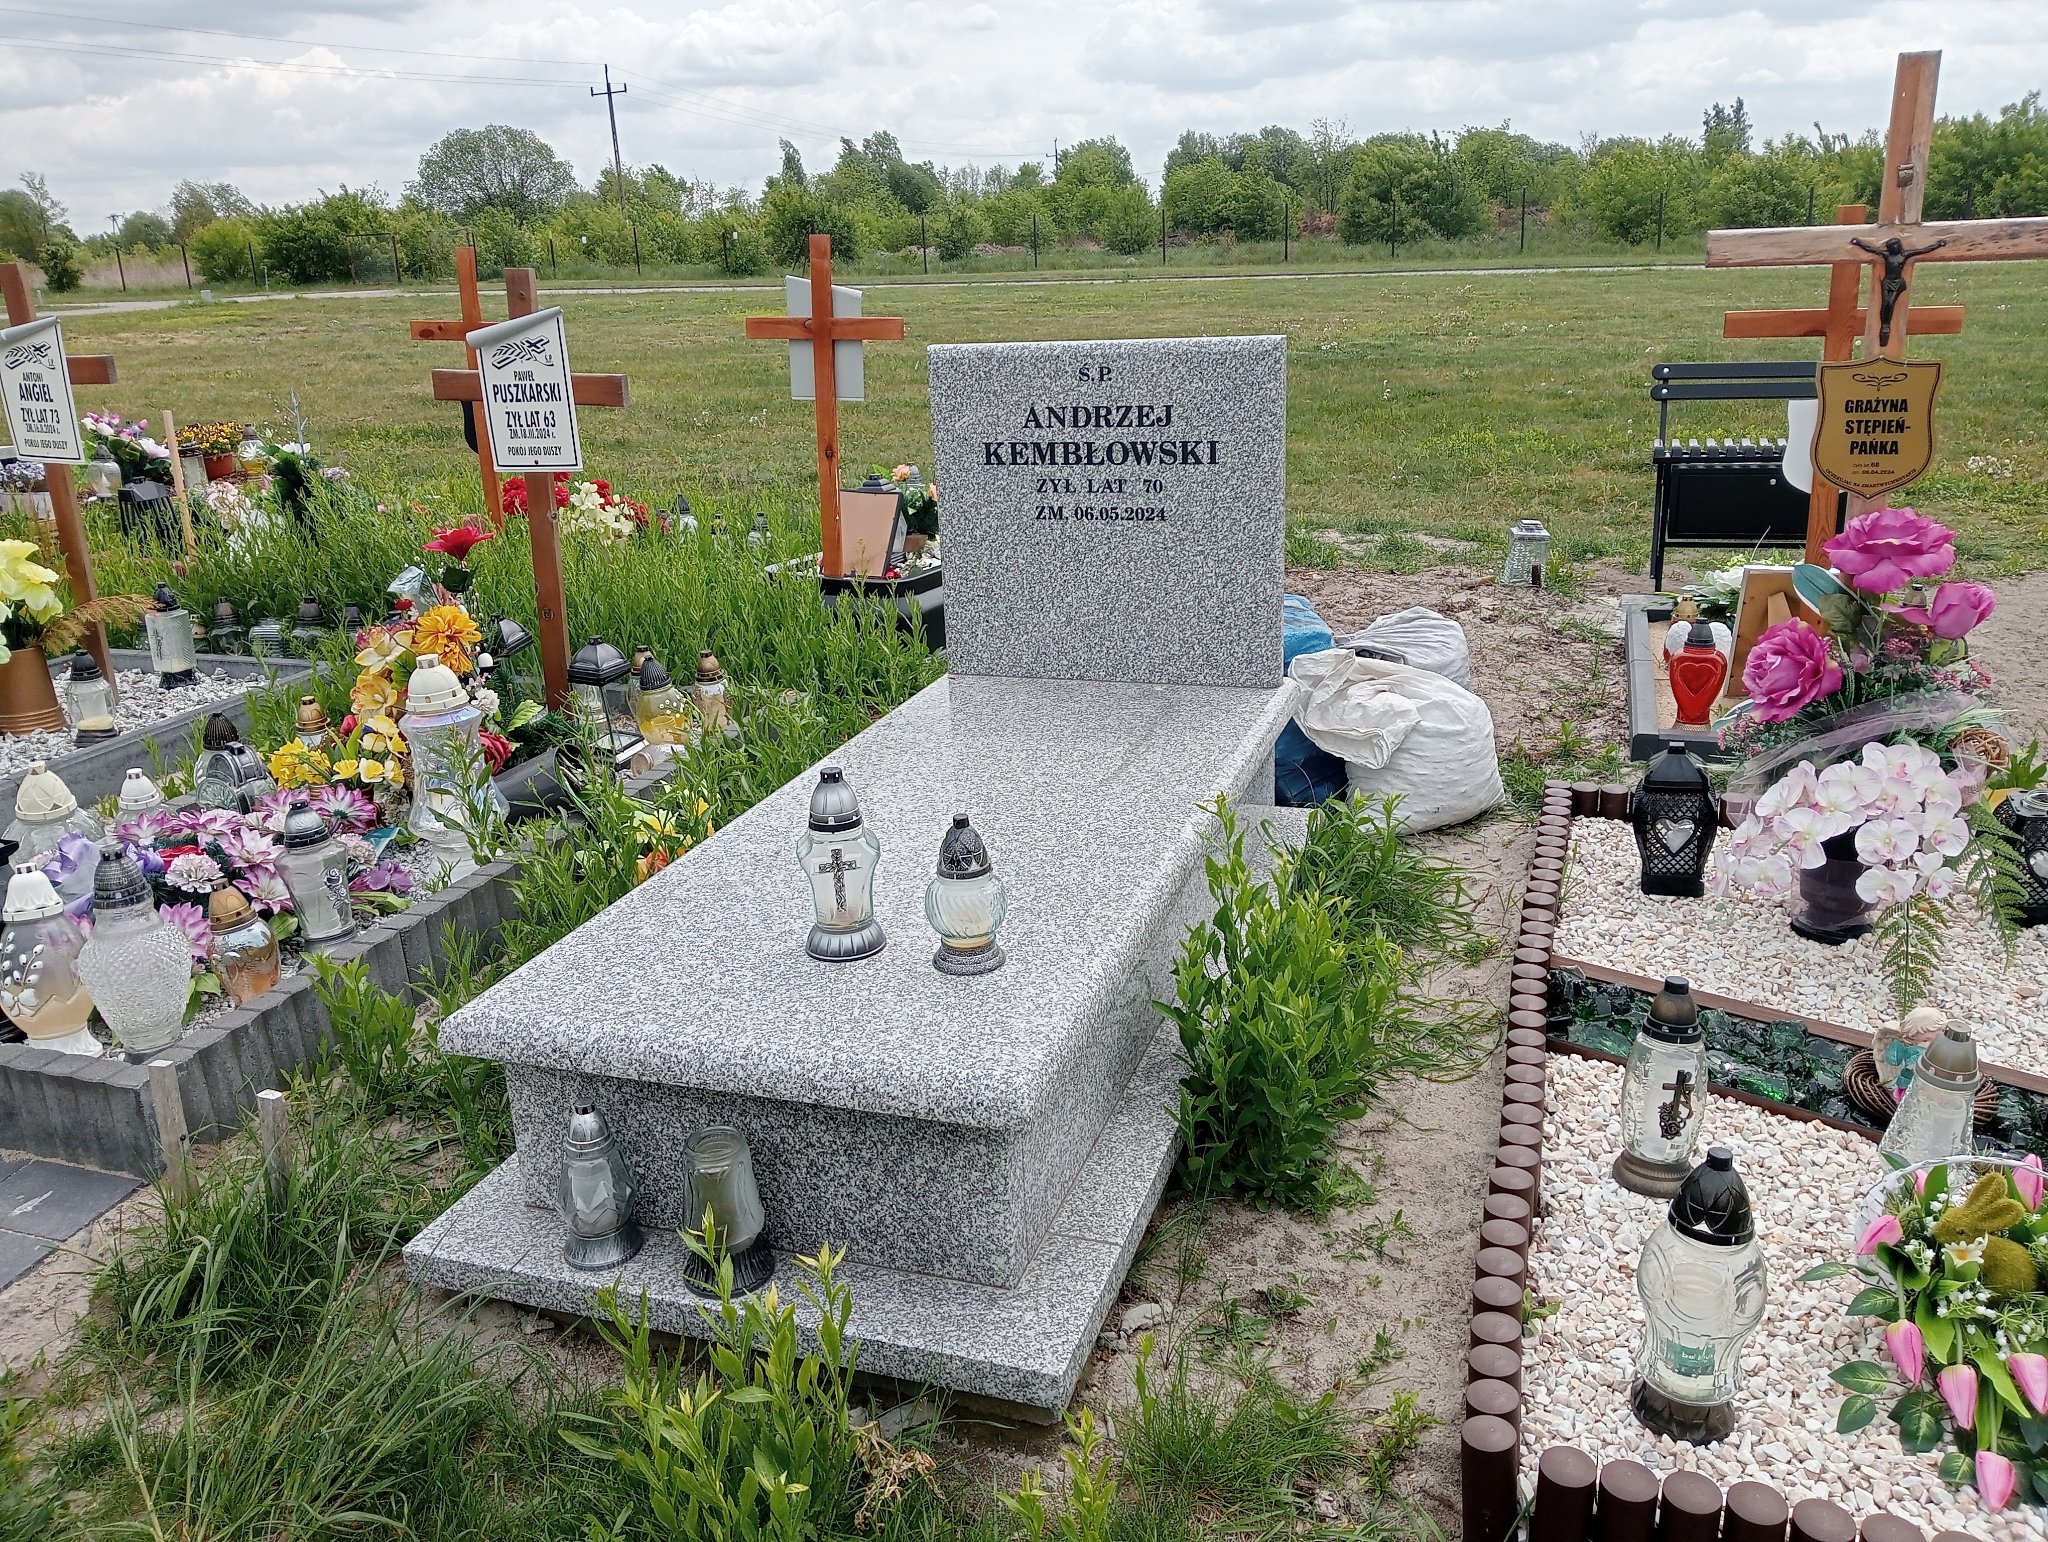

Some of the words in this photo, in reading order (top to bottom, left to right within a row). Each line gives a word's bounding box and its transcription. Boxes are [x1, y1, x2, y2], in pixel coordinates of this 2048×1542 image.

[513, 370, 536, 382] PAWEŁ
[19, 382, 54, 403] ANGIEL
[492, 382, 562, 403] PUSZKARSKI
[1844, 396, 1909, 414] GRAŻYNA
[35, 408, 48, 424] LAT
[49, 408, 60, 425] 73
[524, 410, 540, 428] LAT
[544, 410, 556, 428] 63
[1022, 404, 1175, 429] ANDRZEJ
[1844, 416, 1912, 436] STĘPIEŃ-
[528, 446, 542, 456] JEGO
[543, 445, 562, 456] DUSZY
[982, 440, 1220, 466] KEMBŁOWSKI
[1849, 438, 1900, 456] PAŃKA
[1086, 478, 1128, 493] LAT
[1142, 479, 1163, 493] 70
[1035, 505, 1069, 521] ZM.
[1074, 506, 1168, 521] 06.05.2024
